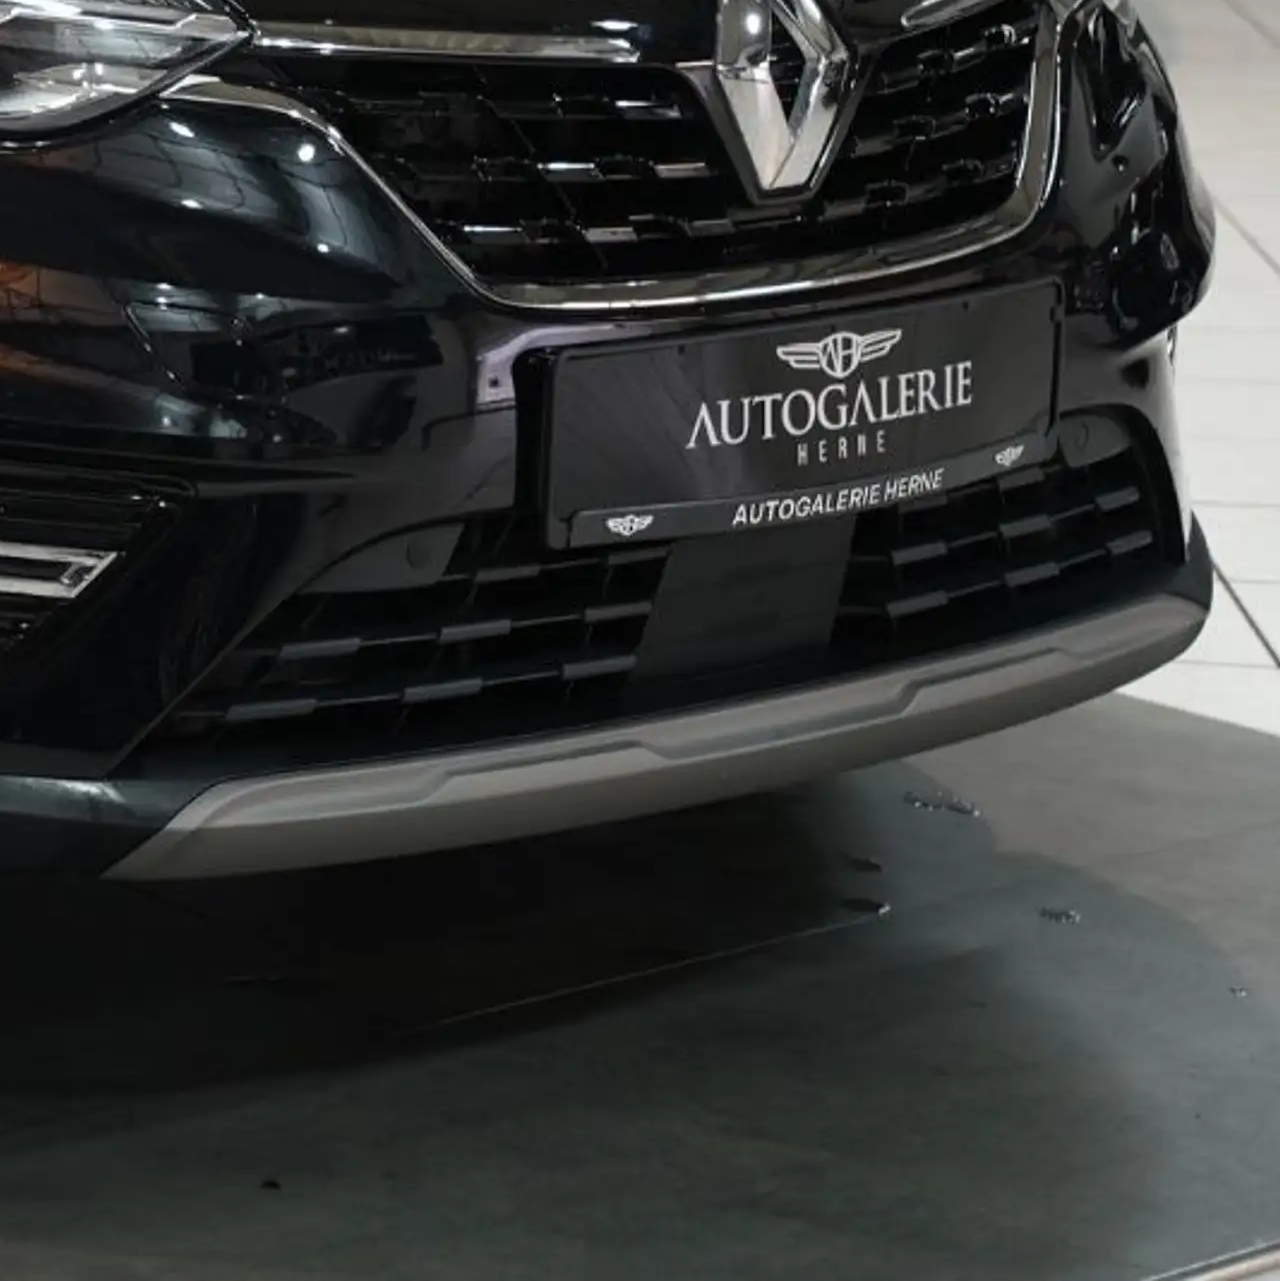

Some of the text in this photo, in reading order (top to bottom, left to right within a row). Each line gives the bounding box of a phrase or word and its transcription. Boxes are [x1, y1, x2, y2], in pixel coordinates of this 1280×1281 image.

[685, 360, 973, 450] AUTOGALERIE
[797, 429, 887, 466] HERNE
[732, 467, 946, 527] AUTOGALERIE HERNE
